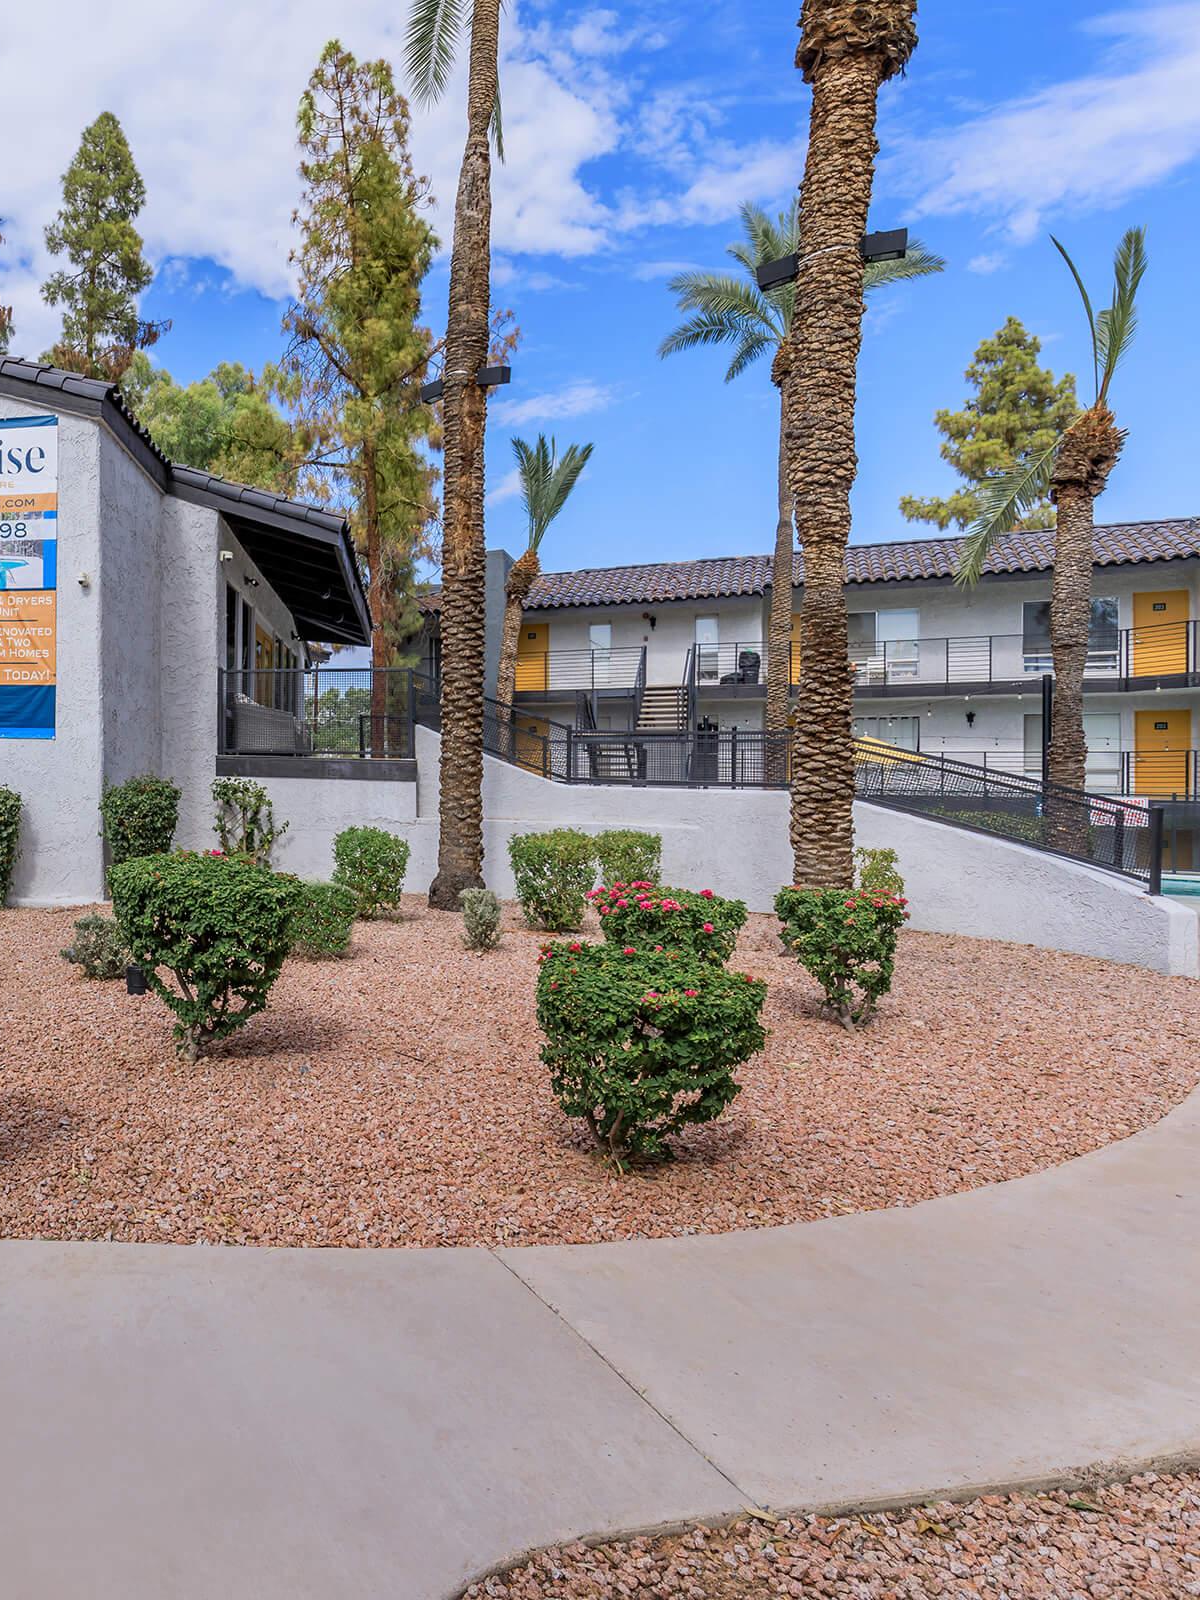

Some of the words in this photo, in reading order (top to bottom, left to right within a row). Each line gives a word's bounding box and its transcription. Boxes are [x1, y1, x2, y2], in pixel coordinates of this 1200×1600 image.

[7, 595, 53, 606] DRYERS
[6, 637, 31, 647] TWO
[9, 648, 49, 658] HOMES
[3, 669, 50, 680] TODAY!
